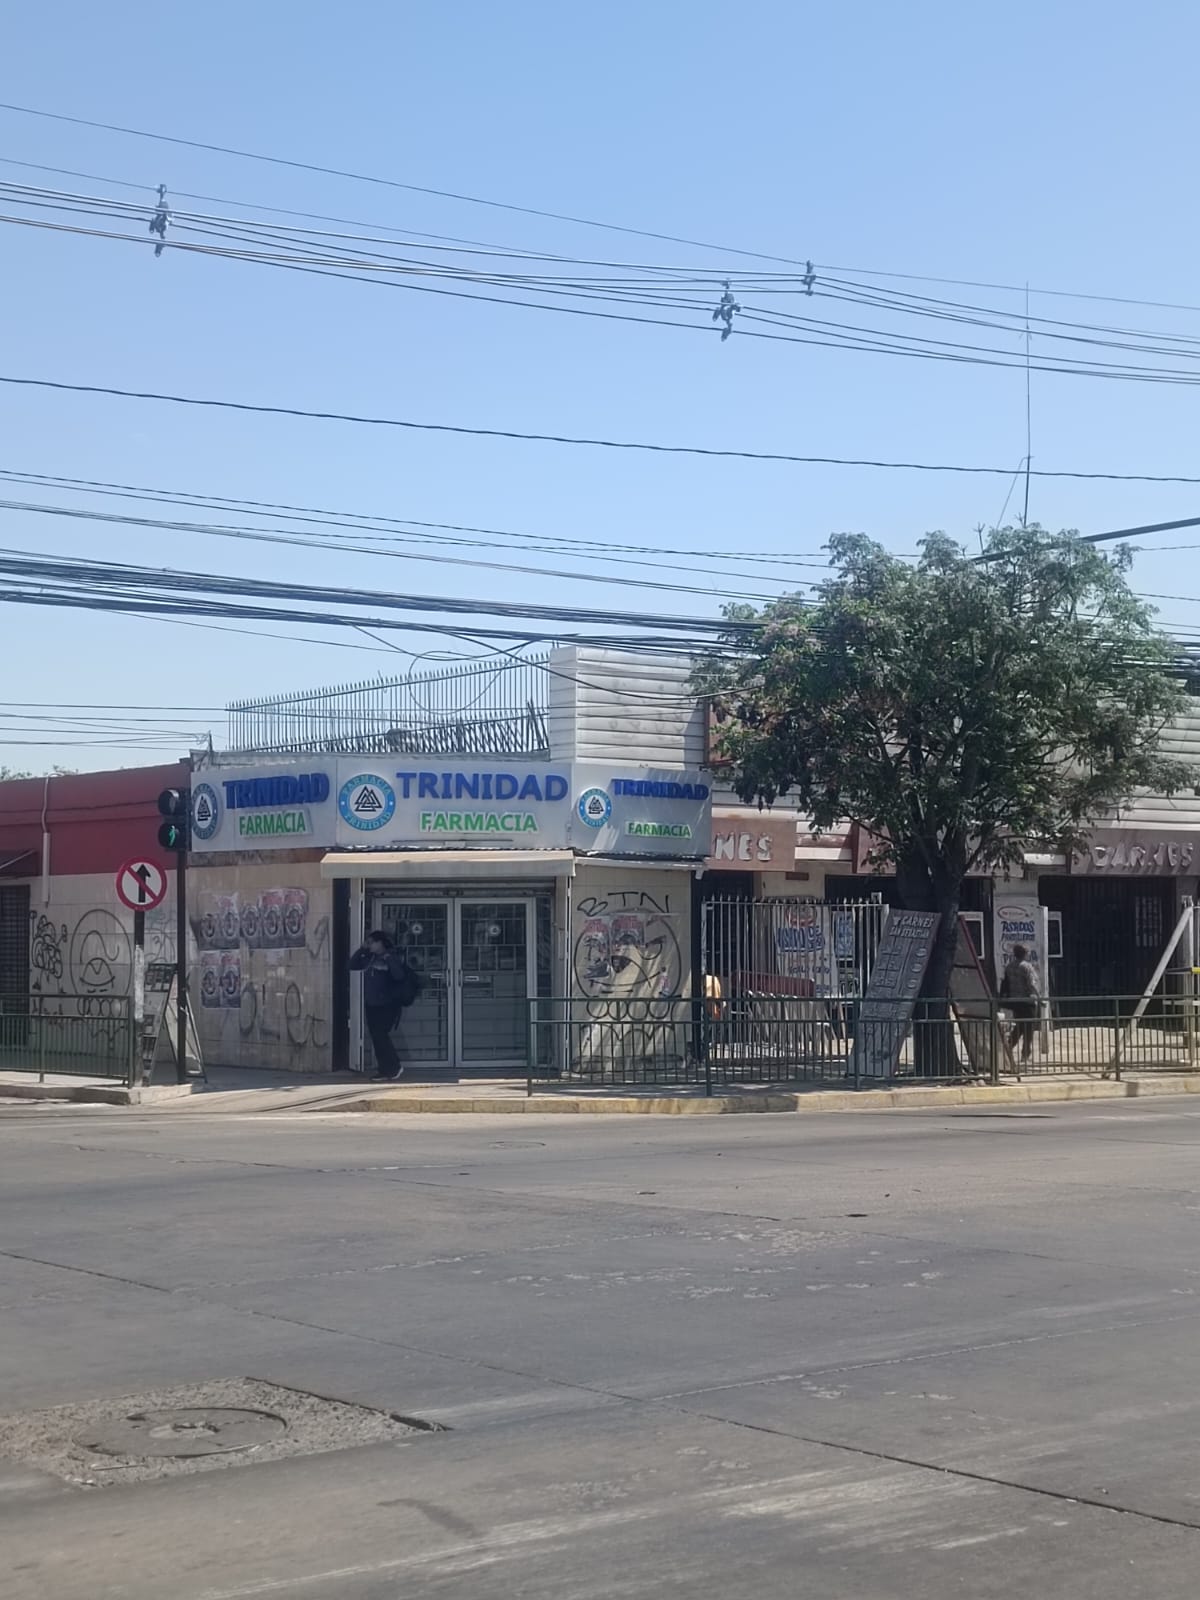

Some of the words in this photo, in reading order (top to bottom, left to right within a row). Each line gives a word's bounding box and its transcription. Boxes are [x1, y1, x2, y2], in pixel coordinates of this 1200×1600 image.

[222, 772, 330, 810] TRINIDAD
[396, 771, 569, 801] TRINIDAD
[611, 778, 709, 800] TRINIDAD
[239, 811, 306, 836] FARMACIA
[420, 811, 538, 832] FARMACIA
[628, 821, 691, 838] FARMACIA
